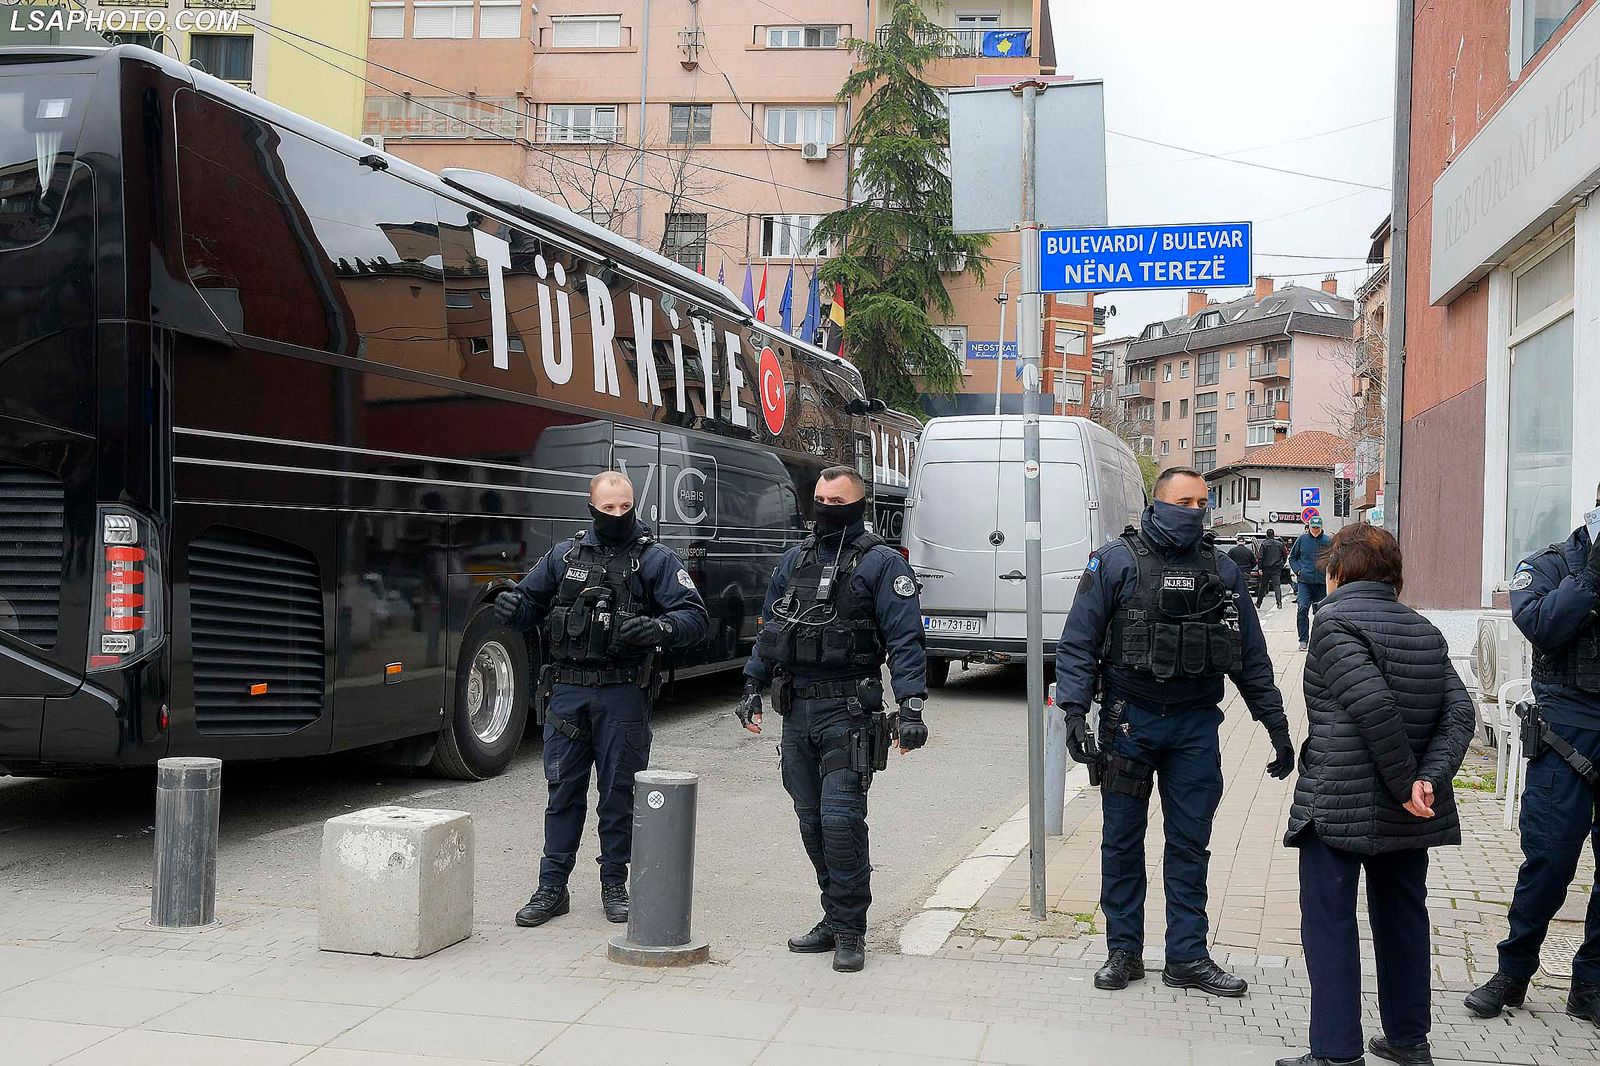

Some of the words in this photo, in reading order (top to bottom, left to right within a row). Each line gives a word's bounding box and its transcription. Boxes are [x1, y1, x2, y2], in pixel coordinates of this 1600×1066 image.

[1444, 116, 1538, 253] RESTORANI
[1046, 233, 1144, 255] BULEVARDI
[1148, 231, 1158, 255] /
[1162, 229, 1244, 251] BULEVAR
[1065, 258, 1133, 284] NËNA
[1138, 254, 1226, 282] TEREZË
[679, 489, 705, 502] PARIS
